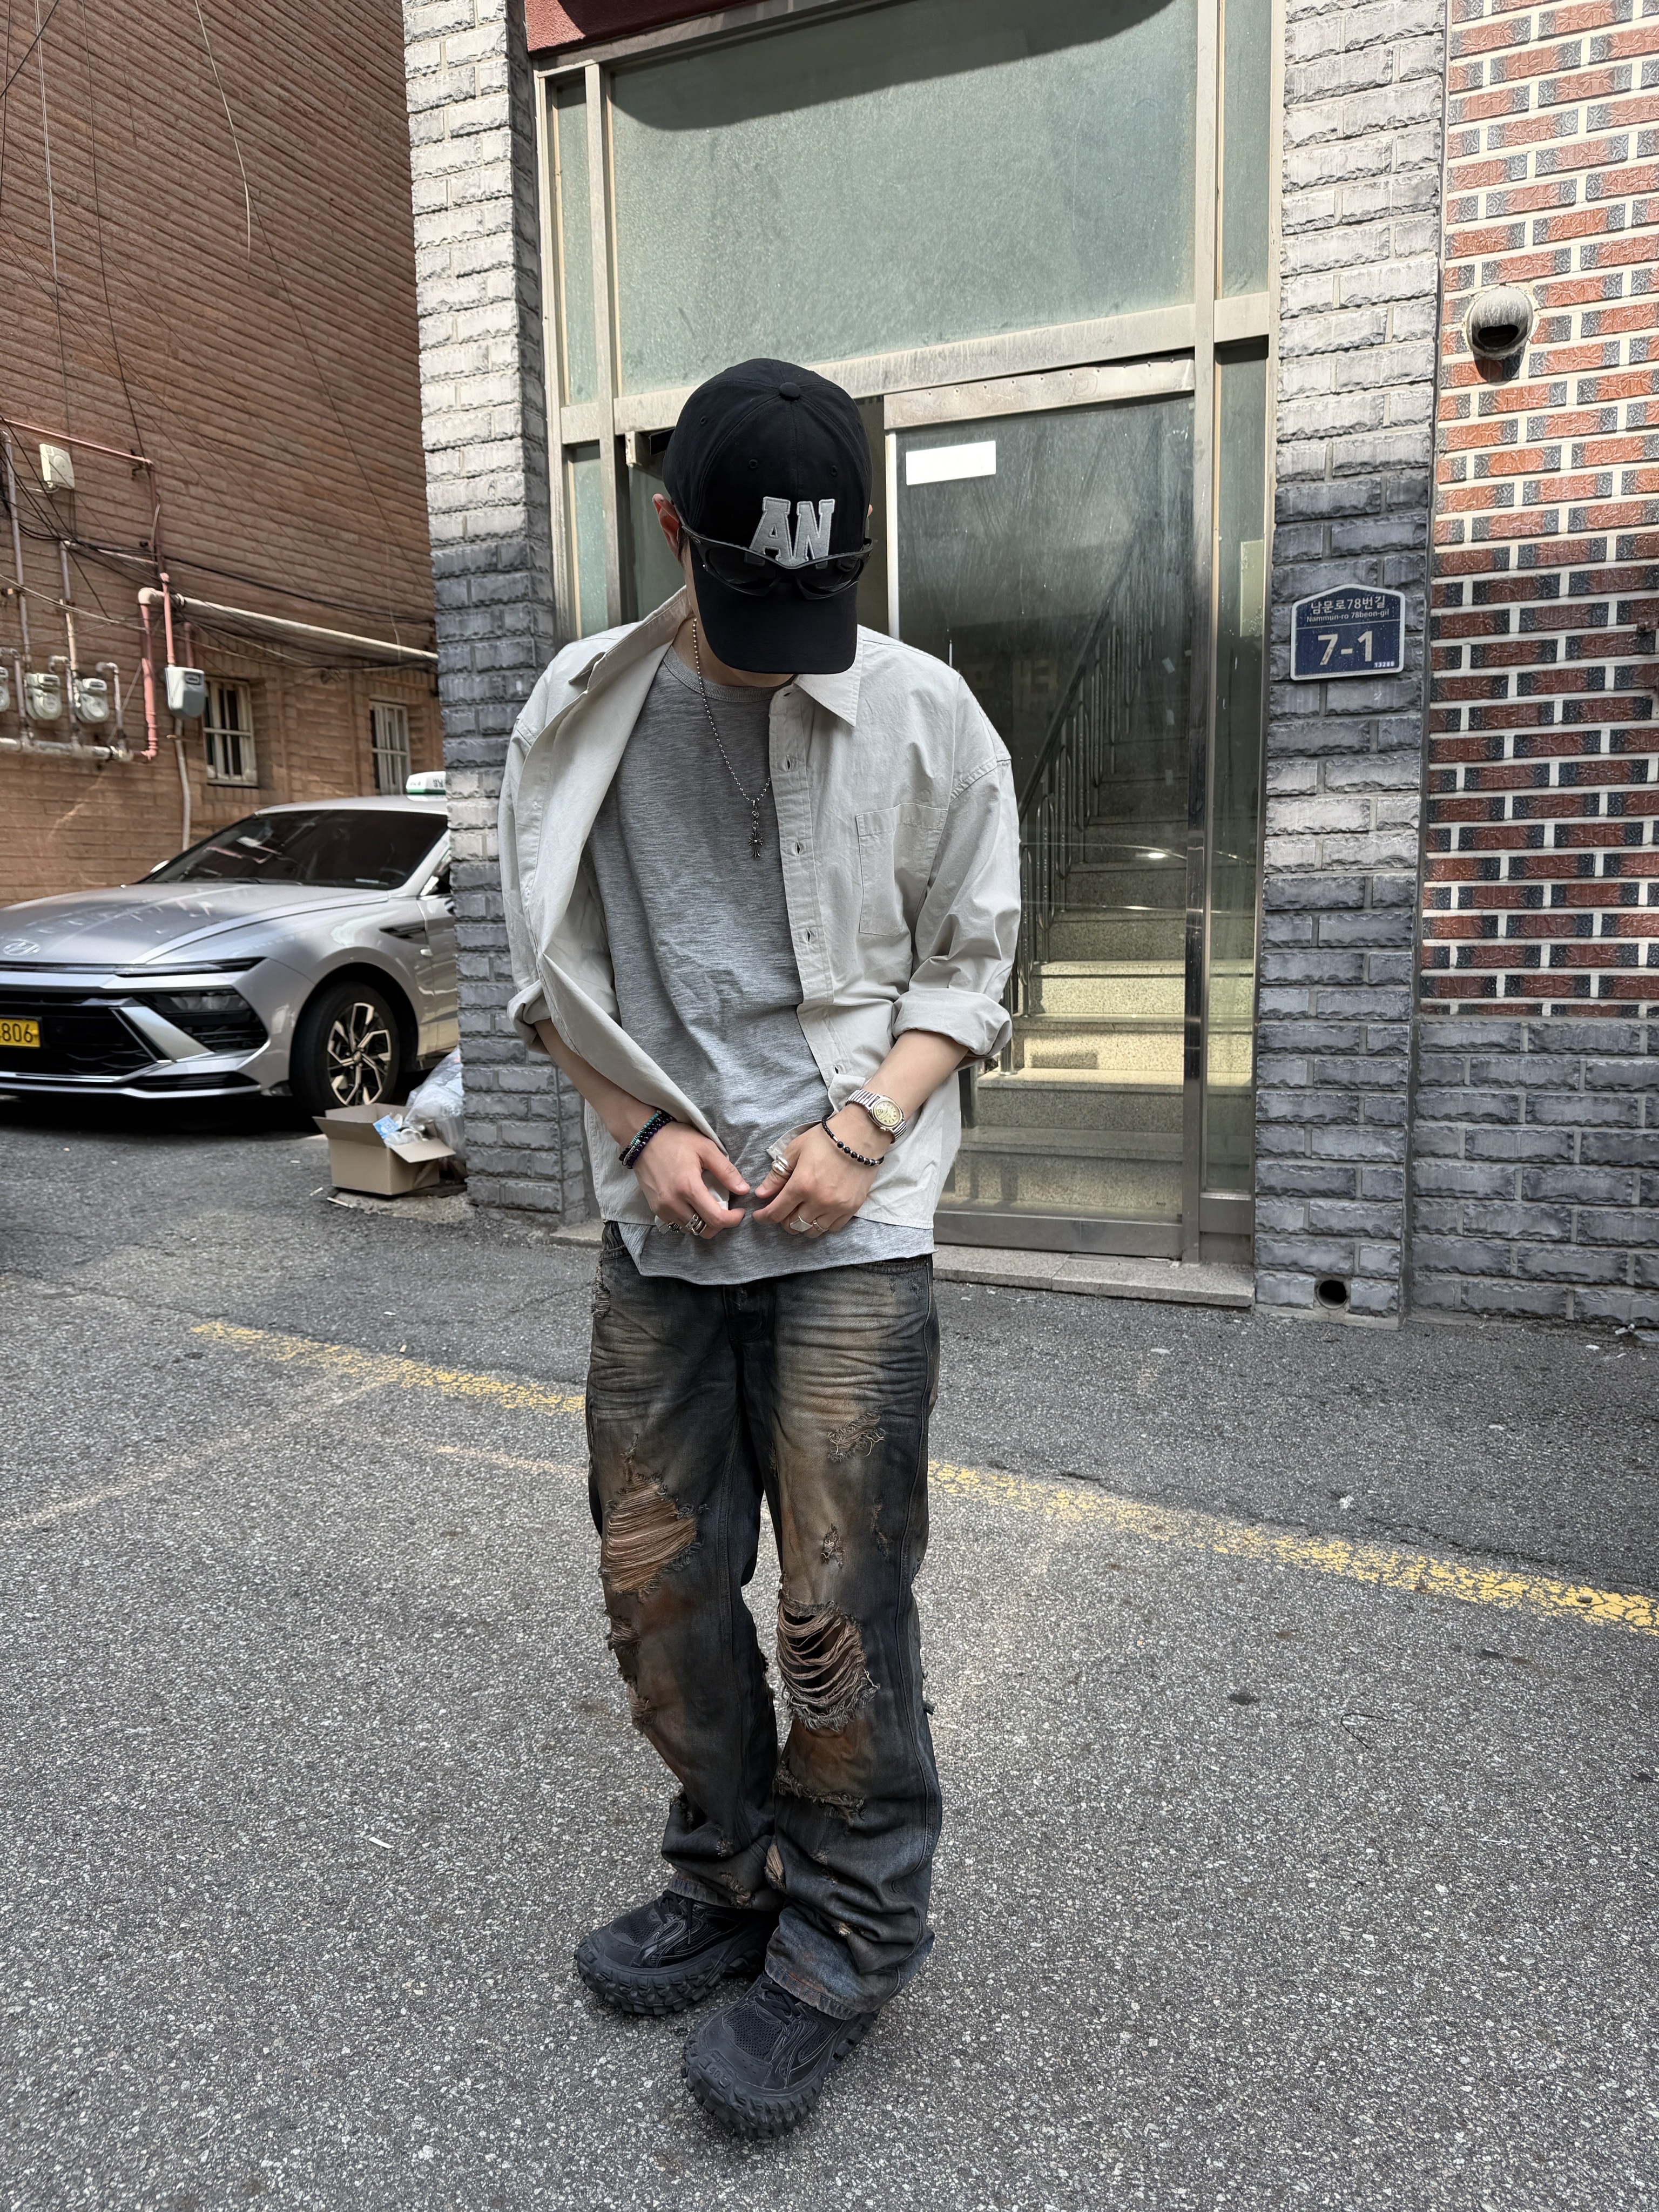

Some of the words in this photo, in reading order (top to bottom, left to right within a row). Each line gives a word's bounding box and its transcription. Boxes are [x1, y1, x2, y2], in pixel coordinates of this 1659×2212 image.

[744, 496, 835, 569] AN
[1311, 595, 1385, 614] 남문로78번길
[1307, 613, 1349, 622] Nammun-ro
[1351, 609, 1389, 618] 78beon-gil
[1318, 631, 1373, 665] 7-1
[0, 1023, 33, 1043] 806
